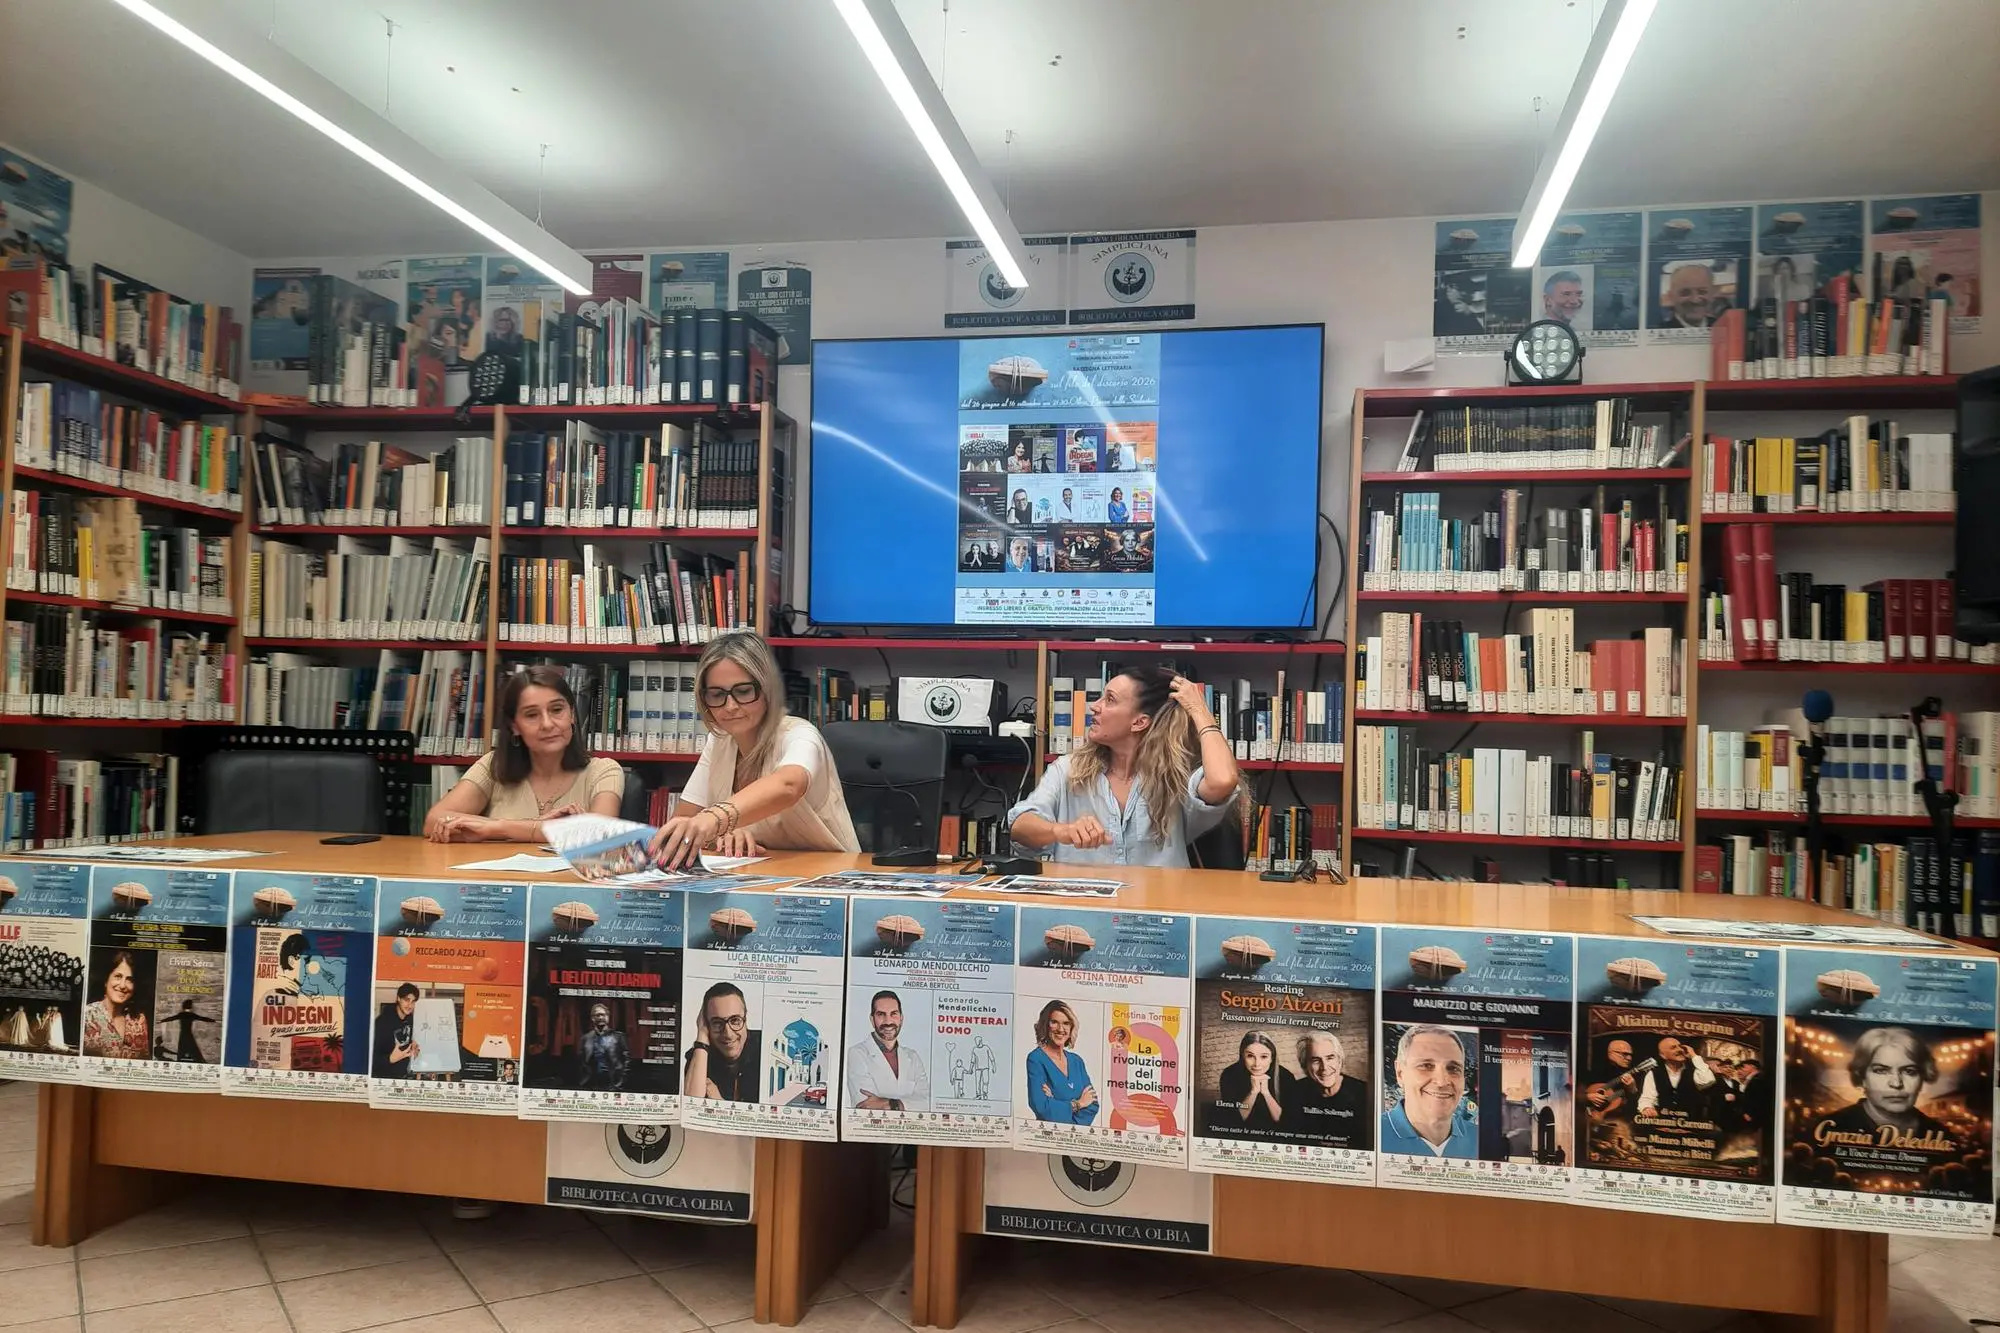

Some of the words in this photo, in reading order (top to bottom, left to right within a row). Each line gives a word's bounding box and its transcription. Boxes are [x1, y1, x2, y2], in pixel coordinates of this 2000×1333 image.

[1091, 242, 1169, 263] SIMPLICIANA
[1132, 377, 1155, 386] 2026
[823, 932, 842, 941] 2026
[992, 940, 1012, 948] 2026
[415, 948, 455, 957] RICCARDO
[457, 949, 486, 958] AZZALI
[727, 953, 749, 961] LUCA
[751, 954, 799, 964] BIANCHINI
[1166, 952, 1187, 960] 2026
[257, 964, 279, 979] ABATE
[874, 959, 919, 969] LEONARDO
[922, 961, 990, 972] MENDOLICCHIO
[1351, 962, 1373, 972] 2026
[562, 970, 604, 986] DELITTO
[620, 972, 661, 988] DARWIN
[733, 973, 765, 981] SALVATORE
[1061, 970, 1104, 981] CRISTINA
[1109, 974, 1144, 984] TOMASI
[1546, 975, 1570, 984] 2026
[1264, 984, 1304, 997] Reading
[265, 995, 286, 1005] GLI
[1220, 991, 1277, 1013] Sergio
[1280, 994, 1343, 1014] Atzeni
[938, 1004, 997, 1013] Mendolicchio
[1413, 998, 1467, 1010] MAURIZIO
[1469, 1001, 1483, 1011] DE
[1486, 1003, 1540, 1015] GIOVANNI
[263, 1006, 333, 1025] INDEGNI
[938, 1015, 1008, 1025] DIVENTERAI
[1113, 1010, 1146, 1020] Cristina
[1149, 1012, 1180, 1022] Tomasi
[1221, 1011, 1265, 1023] Passavamo
[1267, 1015, 1287, 1025] sulla
[1289, 1018, 1309, 1027] terra
[1311, 1018, 1340, 1030] leggeri
[271, 1025, 293, 1037] quasi
[938, 1026, 971, 1035] UOMO
[1616, 1014, 1669, 1028] Mialinu
[1684, 1021, 1735, 1036] crapinu
[1138, 1043, 1151, 1053] La
[1484, 1045, 1519, 1054] Maurizio
[1520, 1046, 1529, 1055] de
[1113, 1054, 1176, 1068] rivoluzione
[1135, 1068, 1153, 1079] del
[1107, 1079, 1182, 1094] metabolismo
[1215, 1100, 1234, 1108] Elena
[1814, 1119, 1873, 1148] Grazia
[1876, 1124, 1956, 1151] Deledda
[561, 1186, 639, 1204] BIBLIOTECA
[642, 1193, 688, 1209] CIVICA
[691, 1198, 733, 1212] OLBIA
[1000, 1215, 1087, 1233] BIBLIOTECA
[1090, 1222, 1141, 1239] CIVICA
[1145, 1228, 1191, 1243] OLBIA
